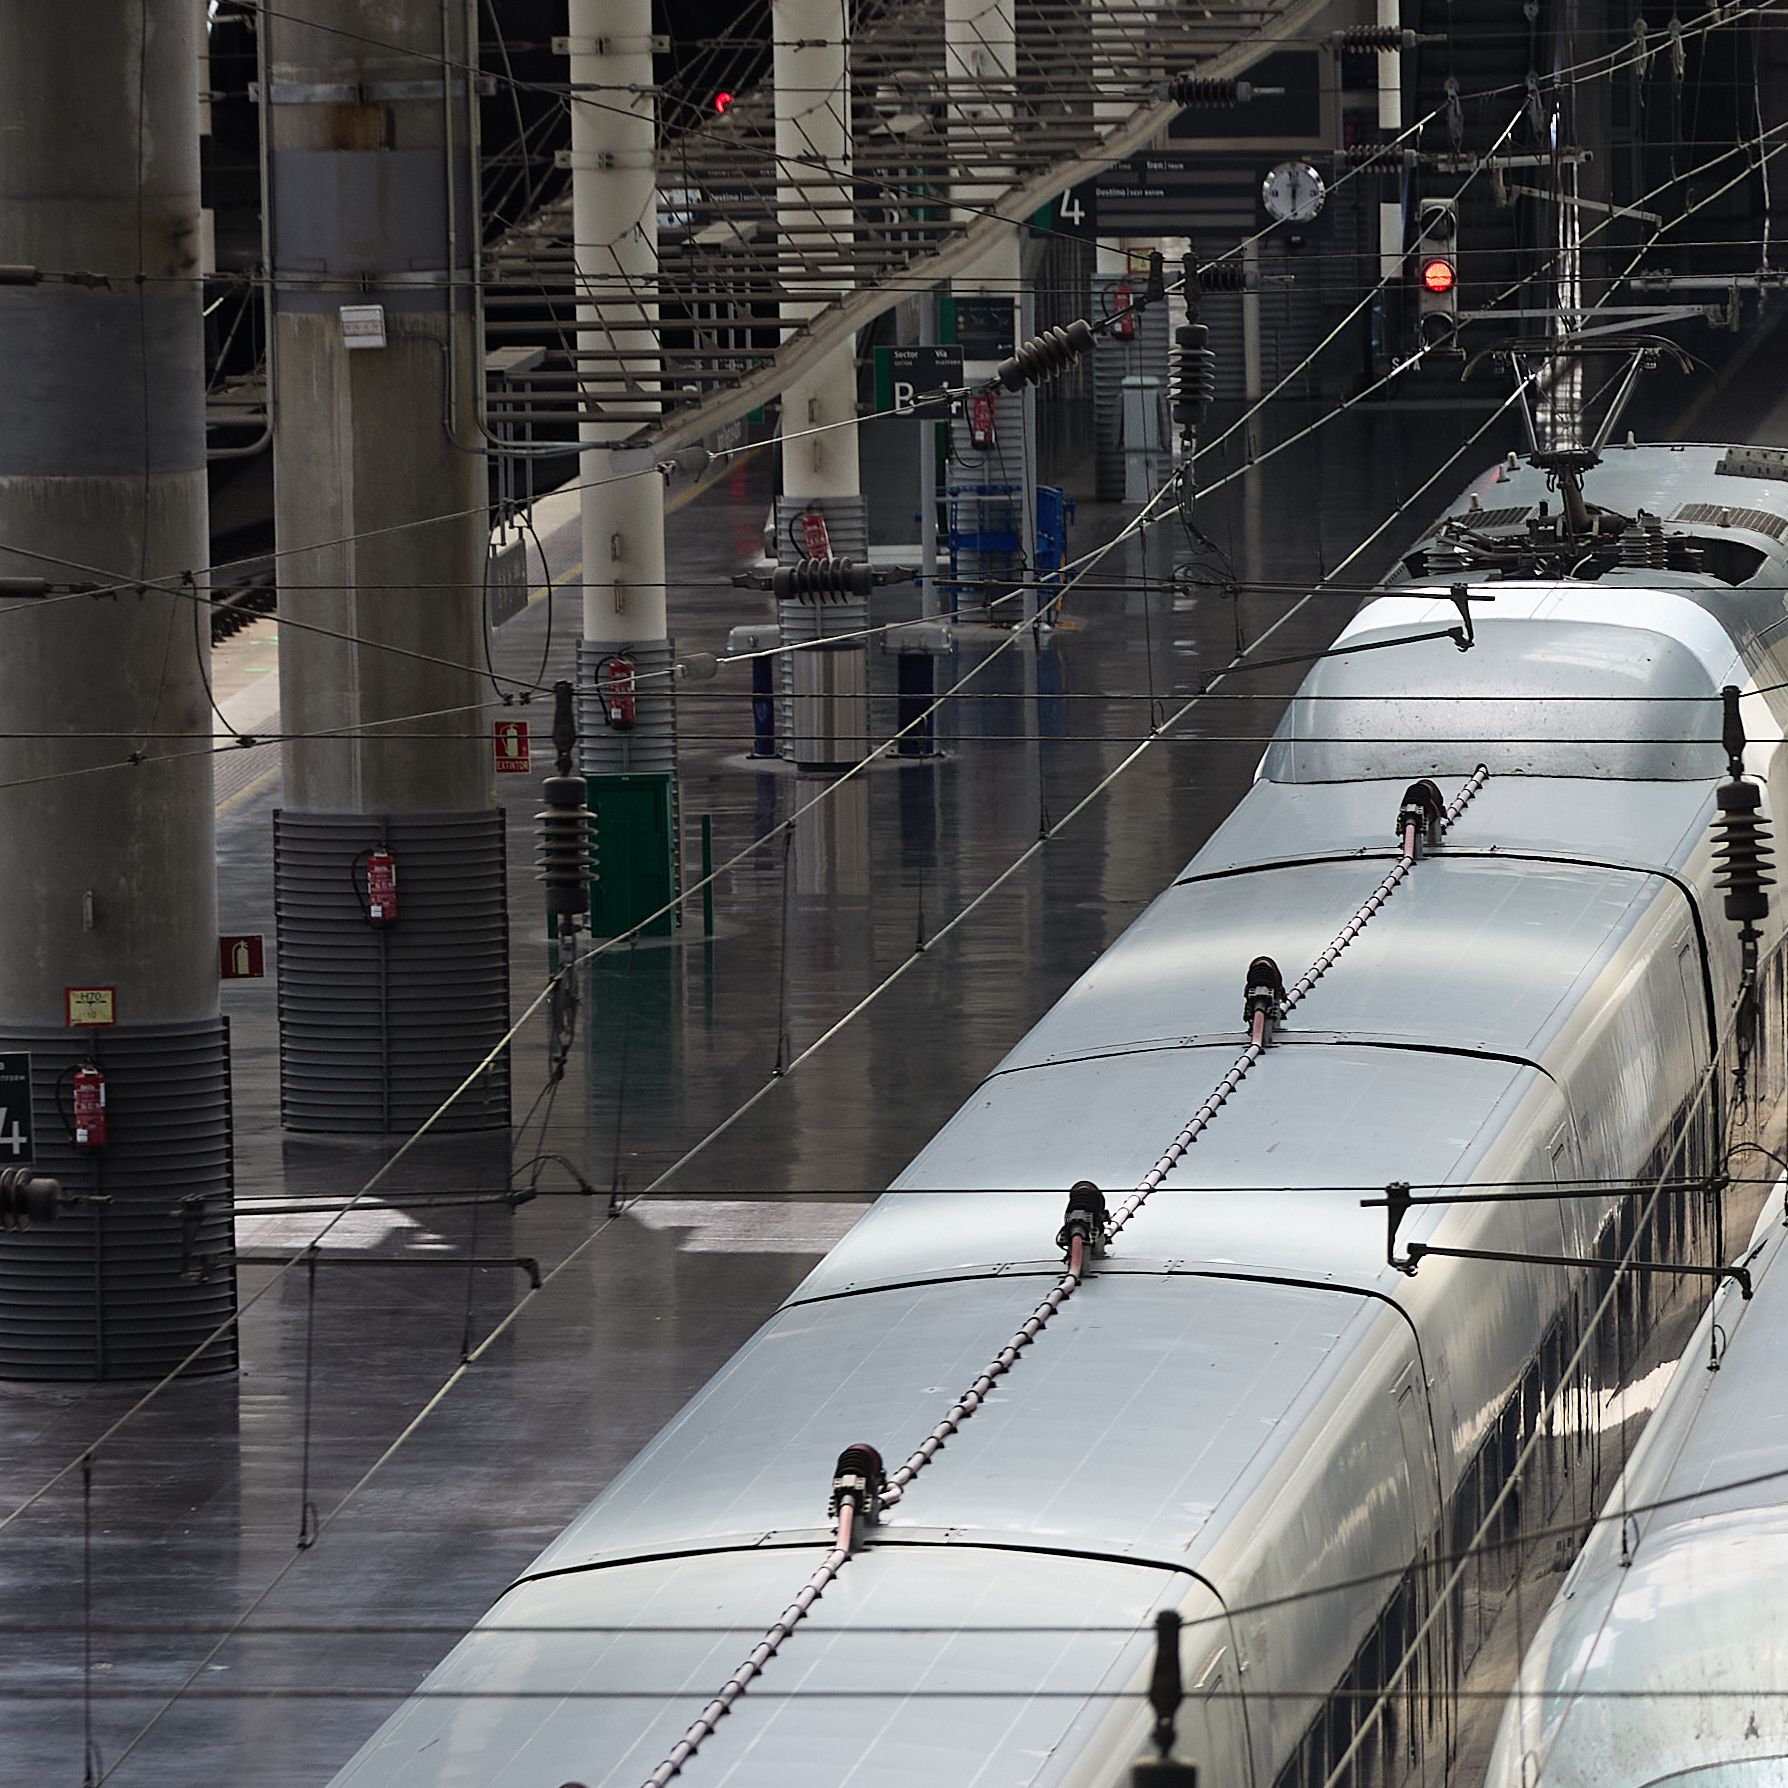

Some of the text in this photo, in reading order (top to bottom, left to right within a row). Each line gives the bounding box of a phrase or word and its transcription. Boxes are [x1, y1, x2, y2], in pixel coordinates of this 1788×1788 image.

[1059, 188, 1086, 227] 4
[893, 381, 916, 416] B
[496, 759, 530, 771] EXTINTOR
